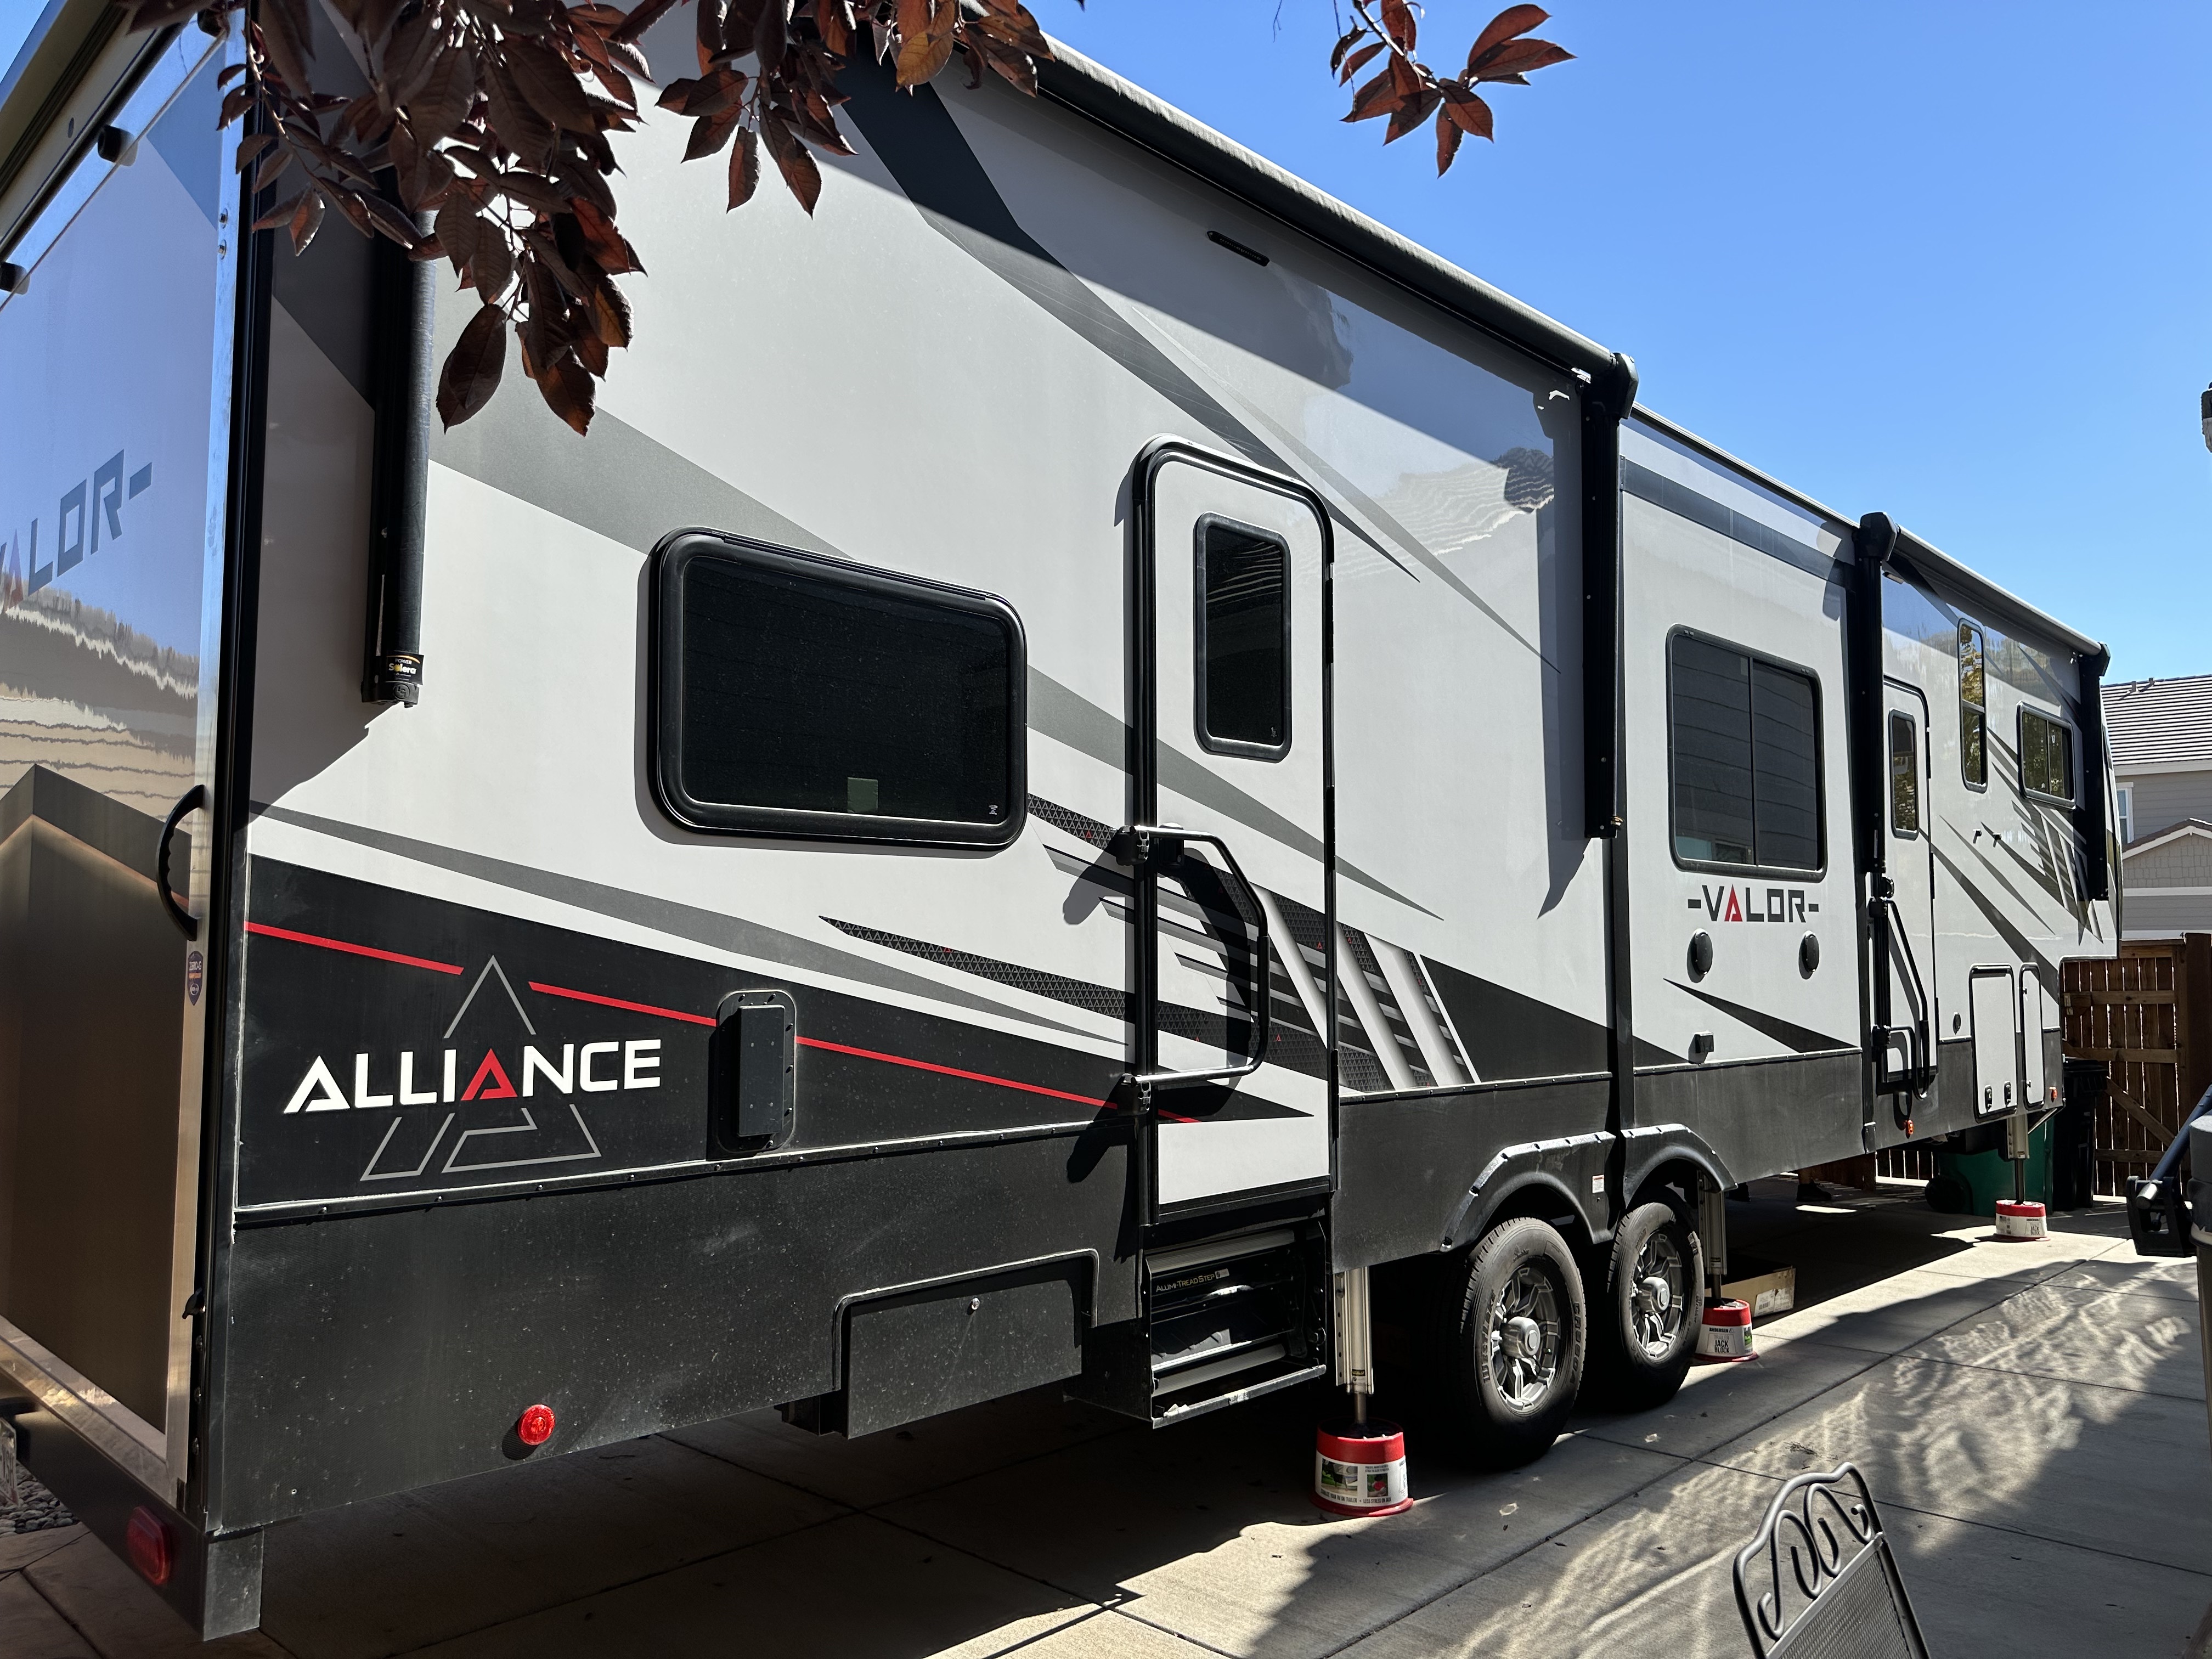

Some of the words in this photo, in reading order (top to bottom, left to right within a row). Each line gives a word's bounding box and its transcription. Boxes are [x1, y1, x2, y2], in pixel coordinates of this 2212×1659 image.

[388, 663, 417, 674] Solera
[189, 961, 202, 971] ZERO-G
[283, 1039, 662, 1114] ALLIANCE
[1714, 1345, 1730, 1353] BLOCK
